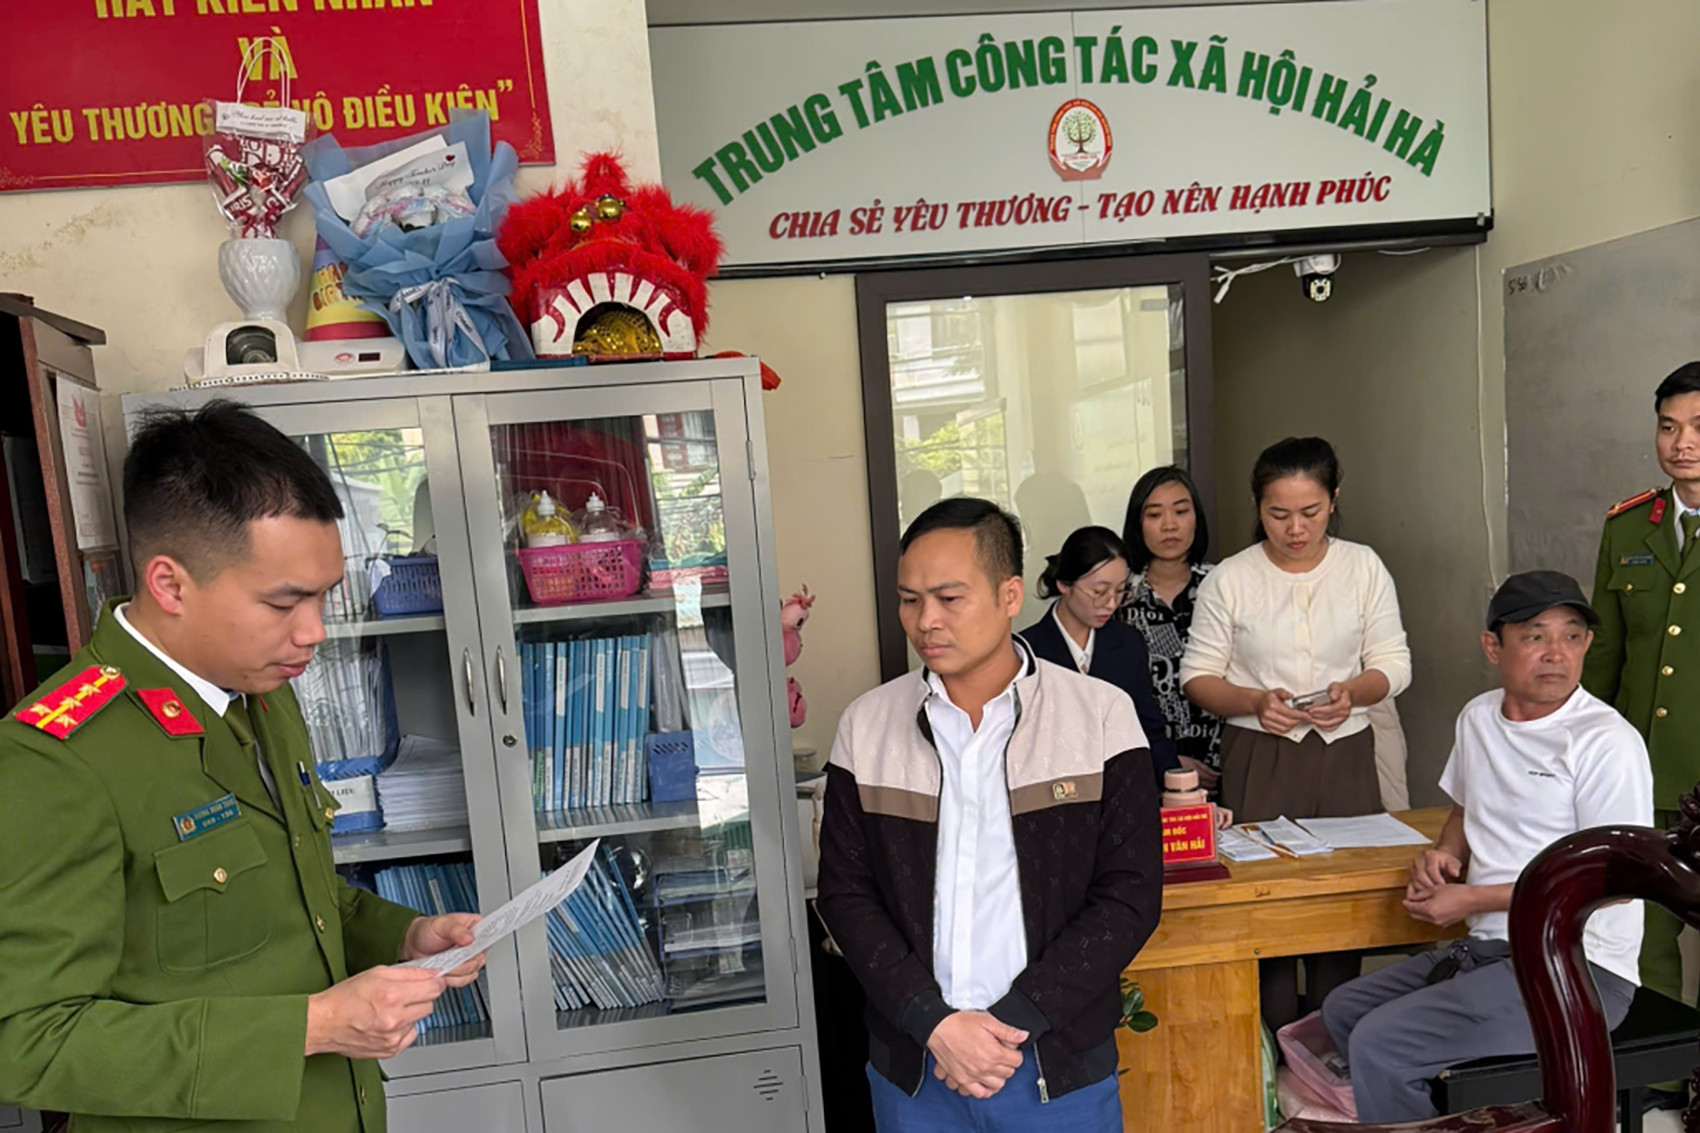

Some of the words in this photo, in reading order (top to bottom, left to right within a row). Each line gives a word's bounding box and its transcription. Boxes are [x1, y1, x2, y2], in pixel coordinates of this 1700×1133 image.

[237, 26, 298, 81] VÀ
[9, 103, 75, 144] YÊU
[82, 101, 216, 141] THƯƠNG
[343, 84, 416, 129] ĐIỀU
[693, 93, 843, 206] TRUNG
[838, 57, 943, 129] TÂM
[945, 33, 1067, 98] CÔNG
[1074, 25, 1158, 84] TÁC
[1166, 34, 1228, 94] XÃ
[1236, 49, 1313, 116] HỘI
[1311, 74, 1392, 143] HẢI
[1383, 108, 1446, 178] HÀ
[768, 209, 841, 240] CHIA
[849, 199, 884, 235] SẺ
[893, 198, 948, 233] YÊU
[957, 192, 1073, 229] THƯƠNG
[1098, 191, 1155, 223] TẠO
[1162, 182, 1222, 216] NÊN
[1229, 181, 1311, 214] HẠNH
[1315, 171, 1393, 206] PHÚC
